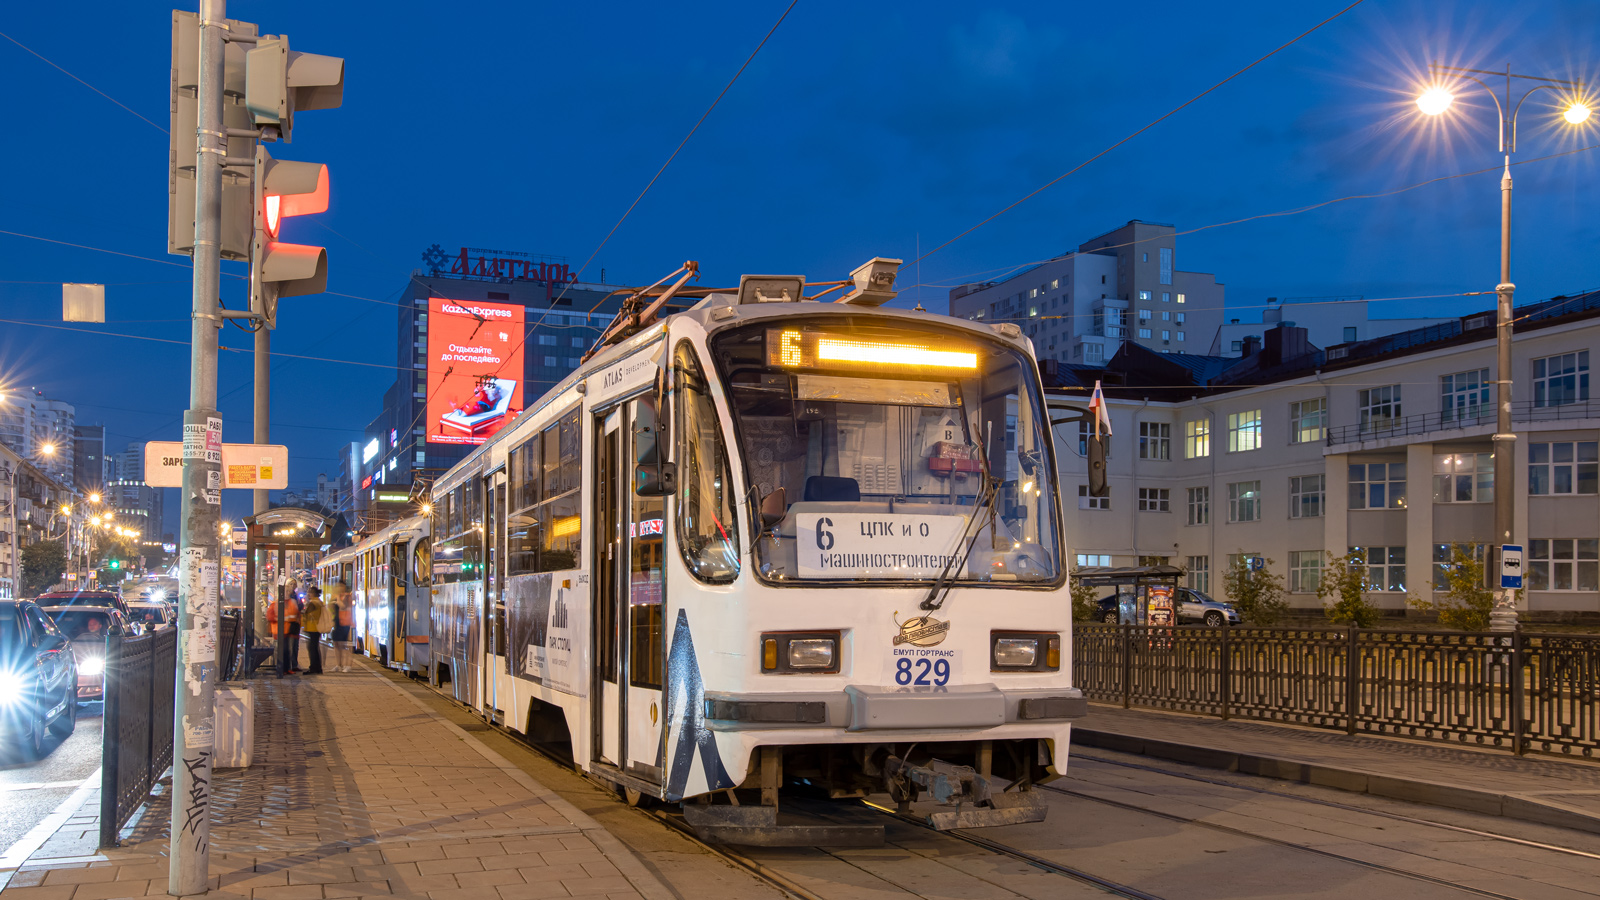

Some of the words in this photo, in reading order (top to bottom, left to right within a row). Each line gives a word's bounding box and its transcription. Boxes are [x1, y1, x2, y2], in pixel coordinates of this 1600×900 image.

[442, 304, 512, 318] KazanExpress
[448, 343, 492, 355] Отдыхайте
[781, 330, 801, 366] 6
[441, 353, 453, 362] до
[603, 367, 623, 390] ATLAS
[183, 425, 206, 434] ОЩЬ
[815, 517, 835, 550] 6
[860, 521, 894, 538] ЦПК
[820, 552, 963, 569] Машиностроителей
[893, 648, 915, 656] ЕМУП
[916, 649, 955, 657] ГОРТРАНС
[895, 657, 951, 687] 829
